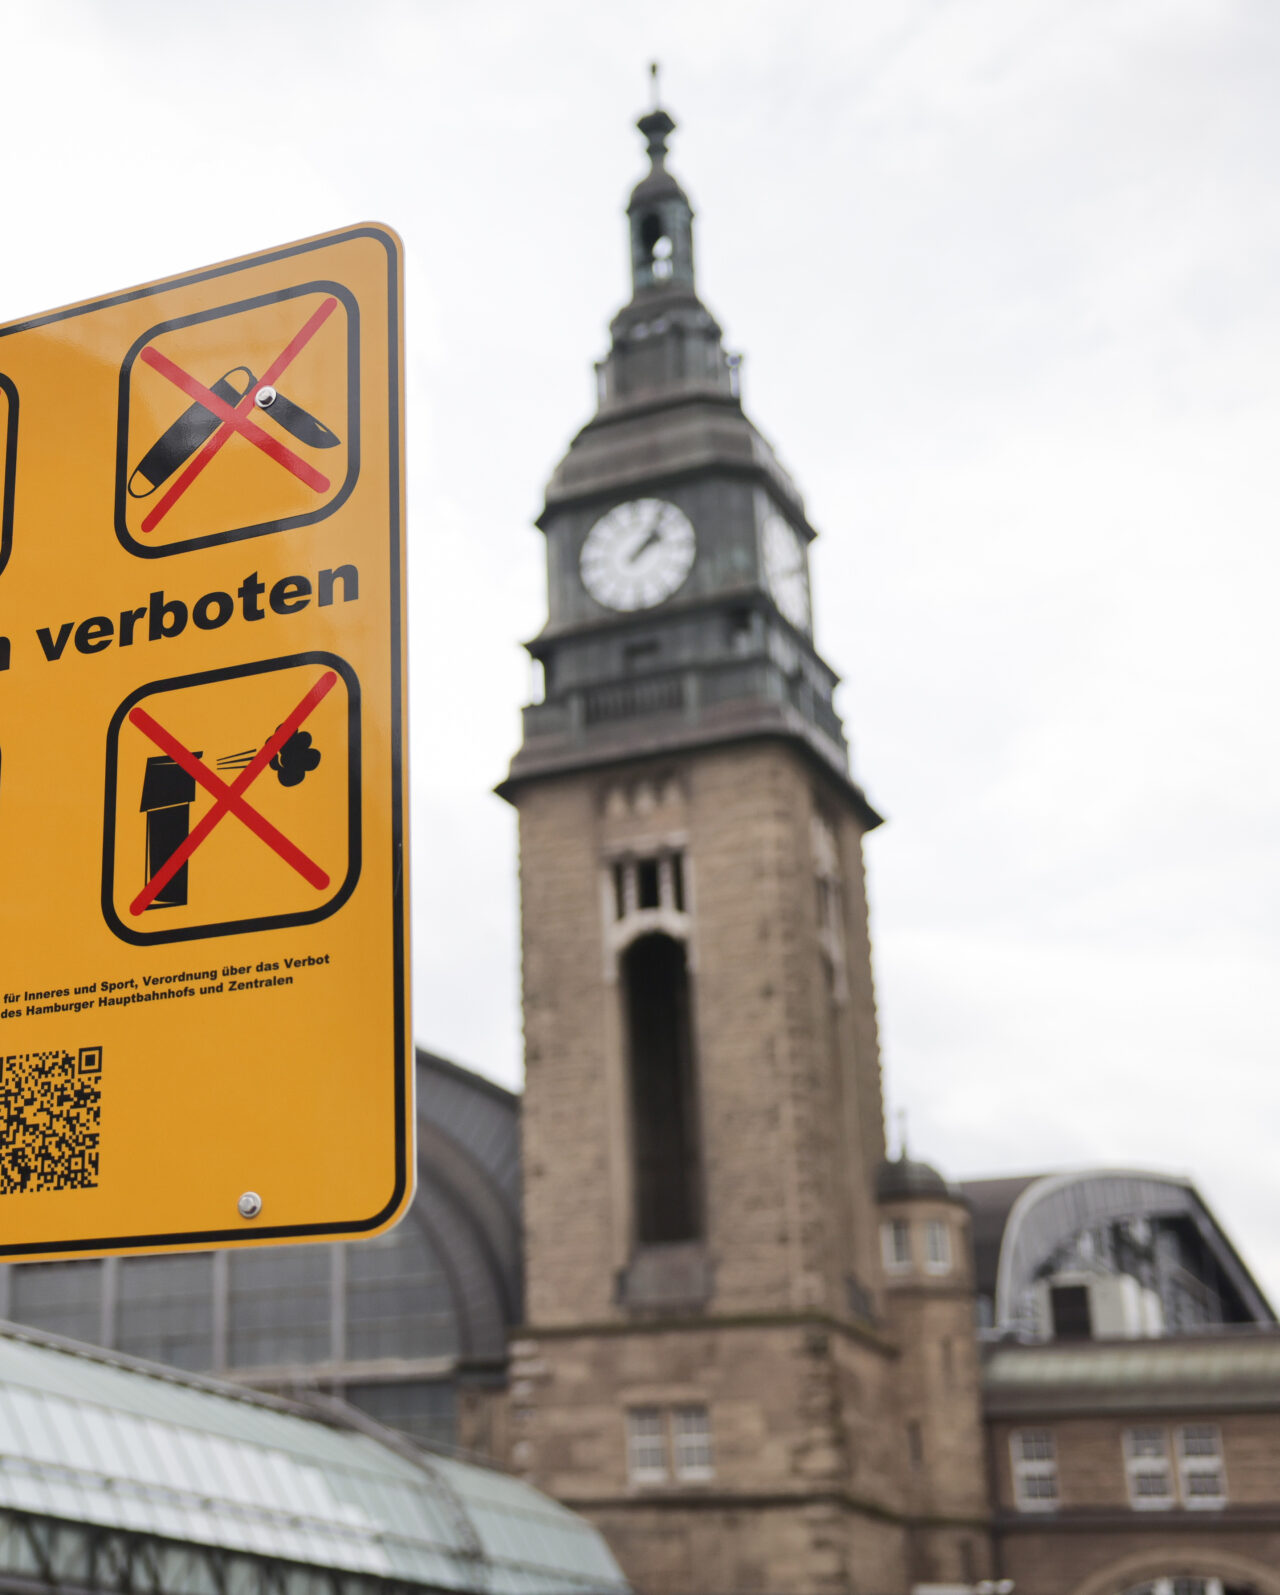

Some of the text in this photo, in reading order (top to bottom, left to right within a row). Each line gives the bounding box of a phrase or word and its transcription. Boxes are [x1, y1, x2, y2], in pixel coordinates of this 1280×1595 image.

[35, 564, 360, 662] verboten
[0, 1008, 22, 1019] des
[26, 1000, 95, 1016] Hamburger
[98, 986, 195, 1007] Hauptbahnhofs
[200, 982, 224, 995] und
[228, 976, 293, 992] Zentralen
[3, 993, 21, 1004] für
[24, 988, 70, 1001] Inneres
[74, 983, 97, 995] und
[101, 978, 138, 993] Sport,
[142, 970, 218, 986] Verordnung
[222, 965, 252, 977] über
[256, 961, 280, 972] das
[284, 954, 330, 969] Verbot
